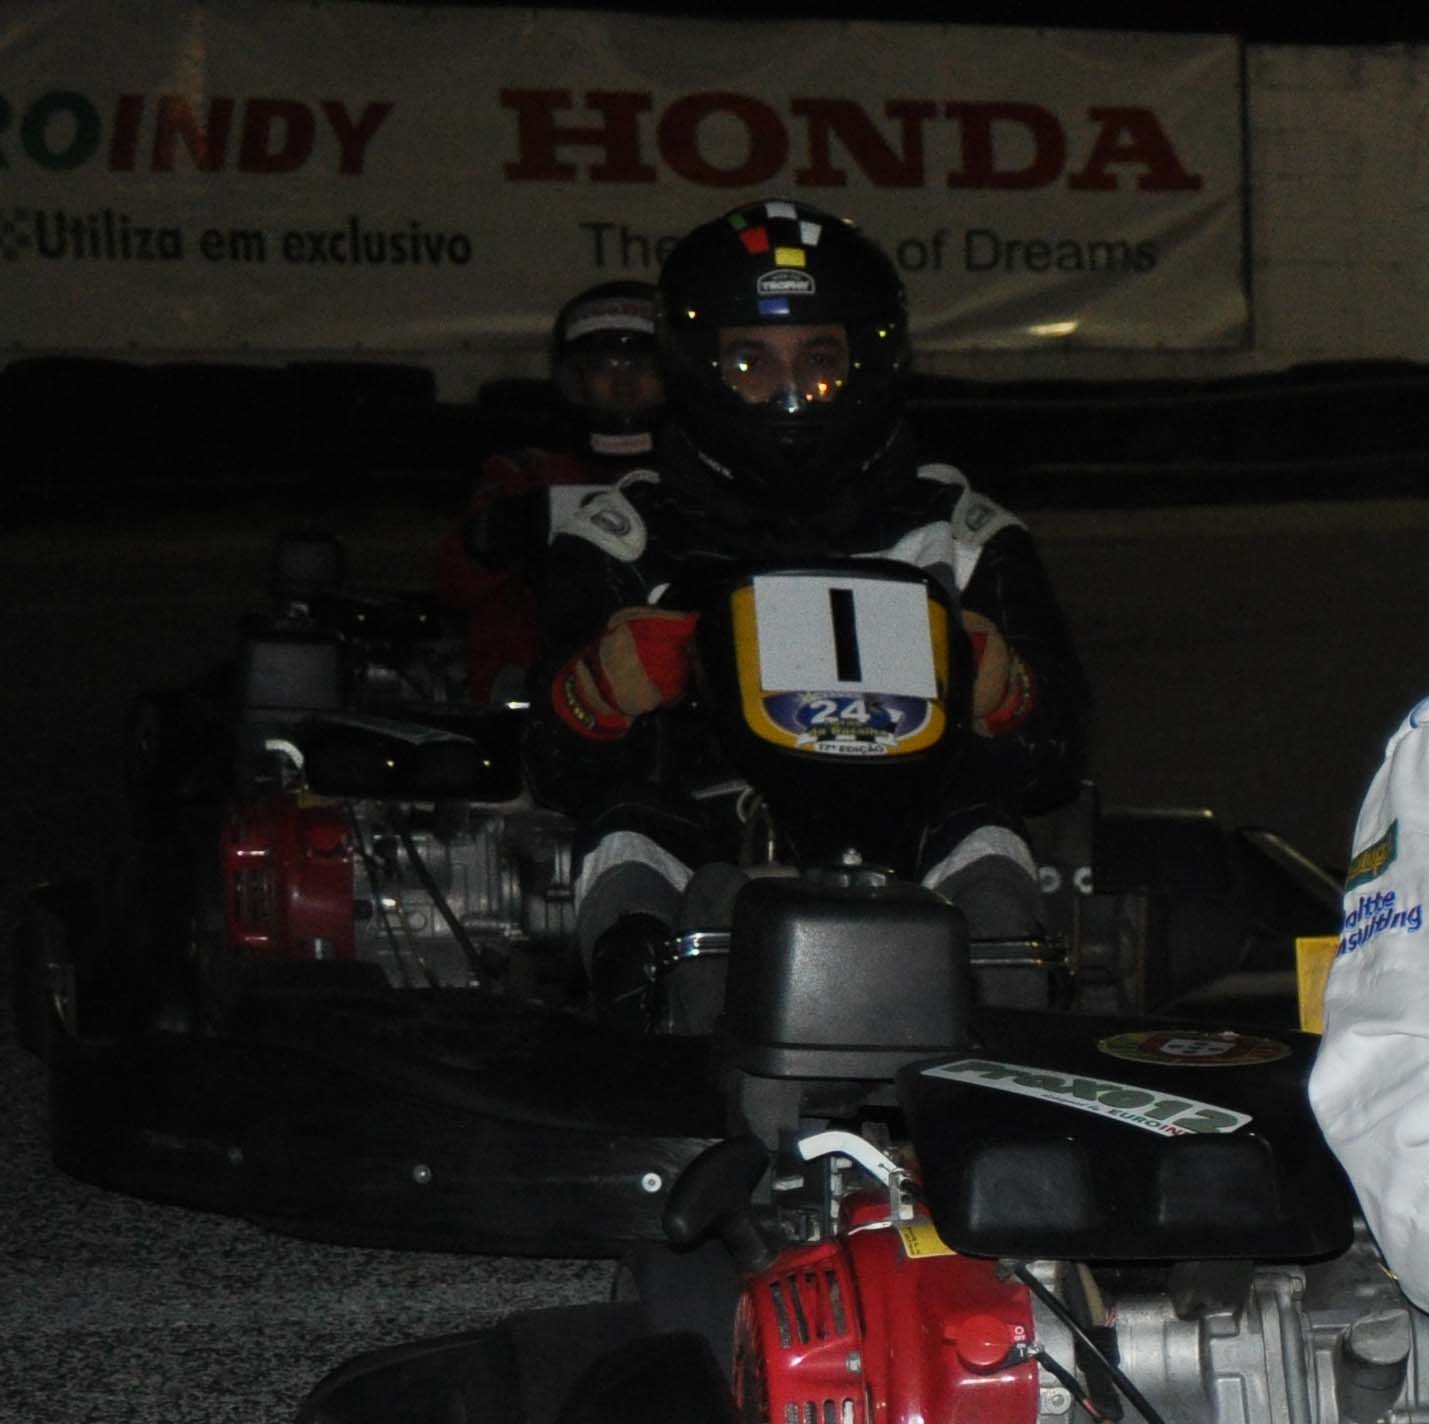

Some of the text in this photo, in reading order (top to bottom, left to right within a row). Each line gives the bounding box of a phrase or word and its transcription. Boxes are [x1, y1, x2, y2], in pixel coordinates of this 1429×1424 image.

[500, 88, 1202, 190] HONDA
[35, 208, 471, 266] Utiliza em exclusivo
[897, 229, 946, 270] of
[965, 229, 1157, 272] Dreams
[809, 700, 871, 725] 24
